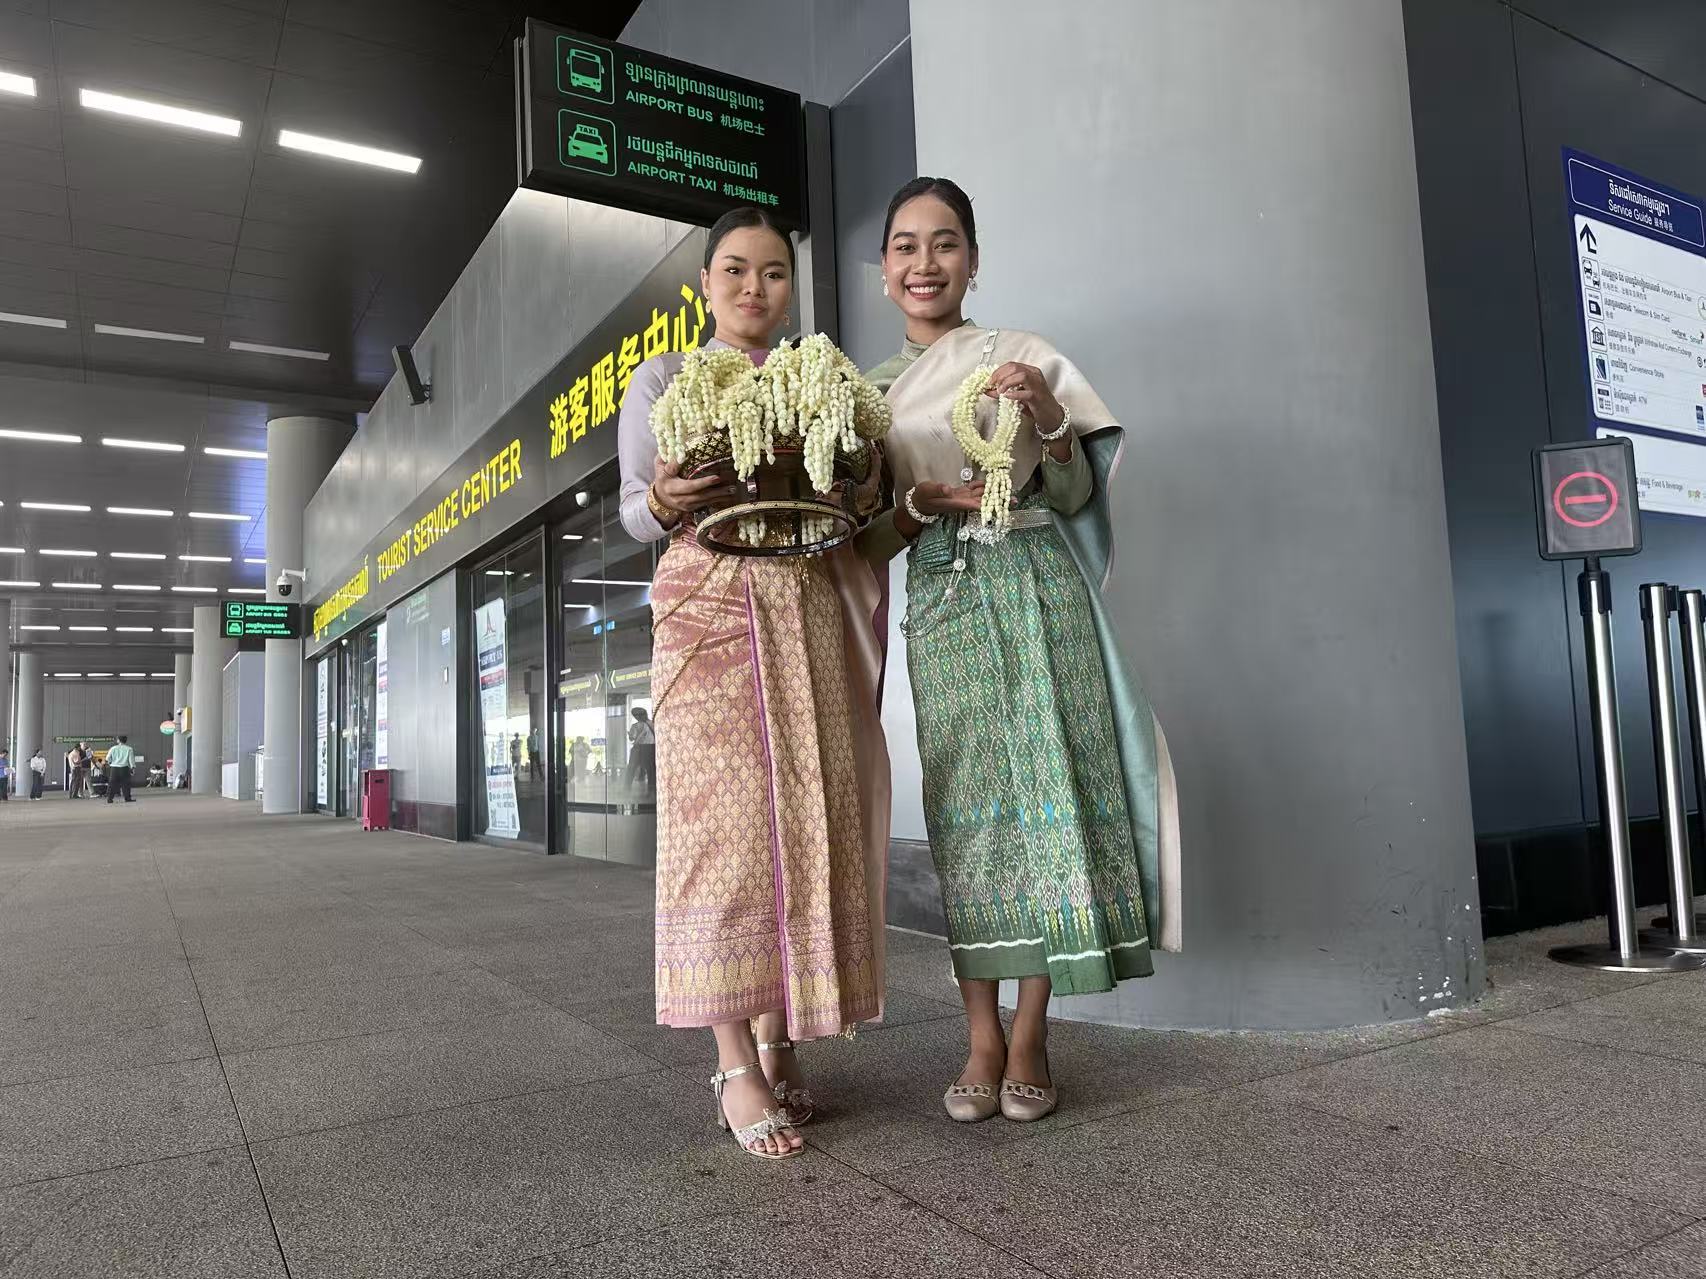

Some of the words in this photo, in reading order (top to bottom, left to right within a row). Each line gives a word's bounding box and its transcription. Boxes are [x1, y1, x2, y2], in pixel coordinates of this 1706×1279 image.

[578, 125, 597, 135] TAXI
[626, 90, 684, 114] AIRPORT
[687, 105, 714, 122] BUS
[720, 113, 766, 136] 机场巴士
[627, 161, 686, 184] AIRPORT
[689, 174, 717, 192] TAXI
[723, 182, 780, 207] 机场出租车
[1608, 198, 1633, 218] Service
[1633, 208, 1653, 225] Guide
[550, 284, 706, 460] 游客服务中心
[377, 528, 412, 584] TOURIST
[413, 488, 459, 557] SERVICE
[461, 438, 523, 519] CENTER
